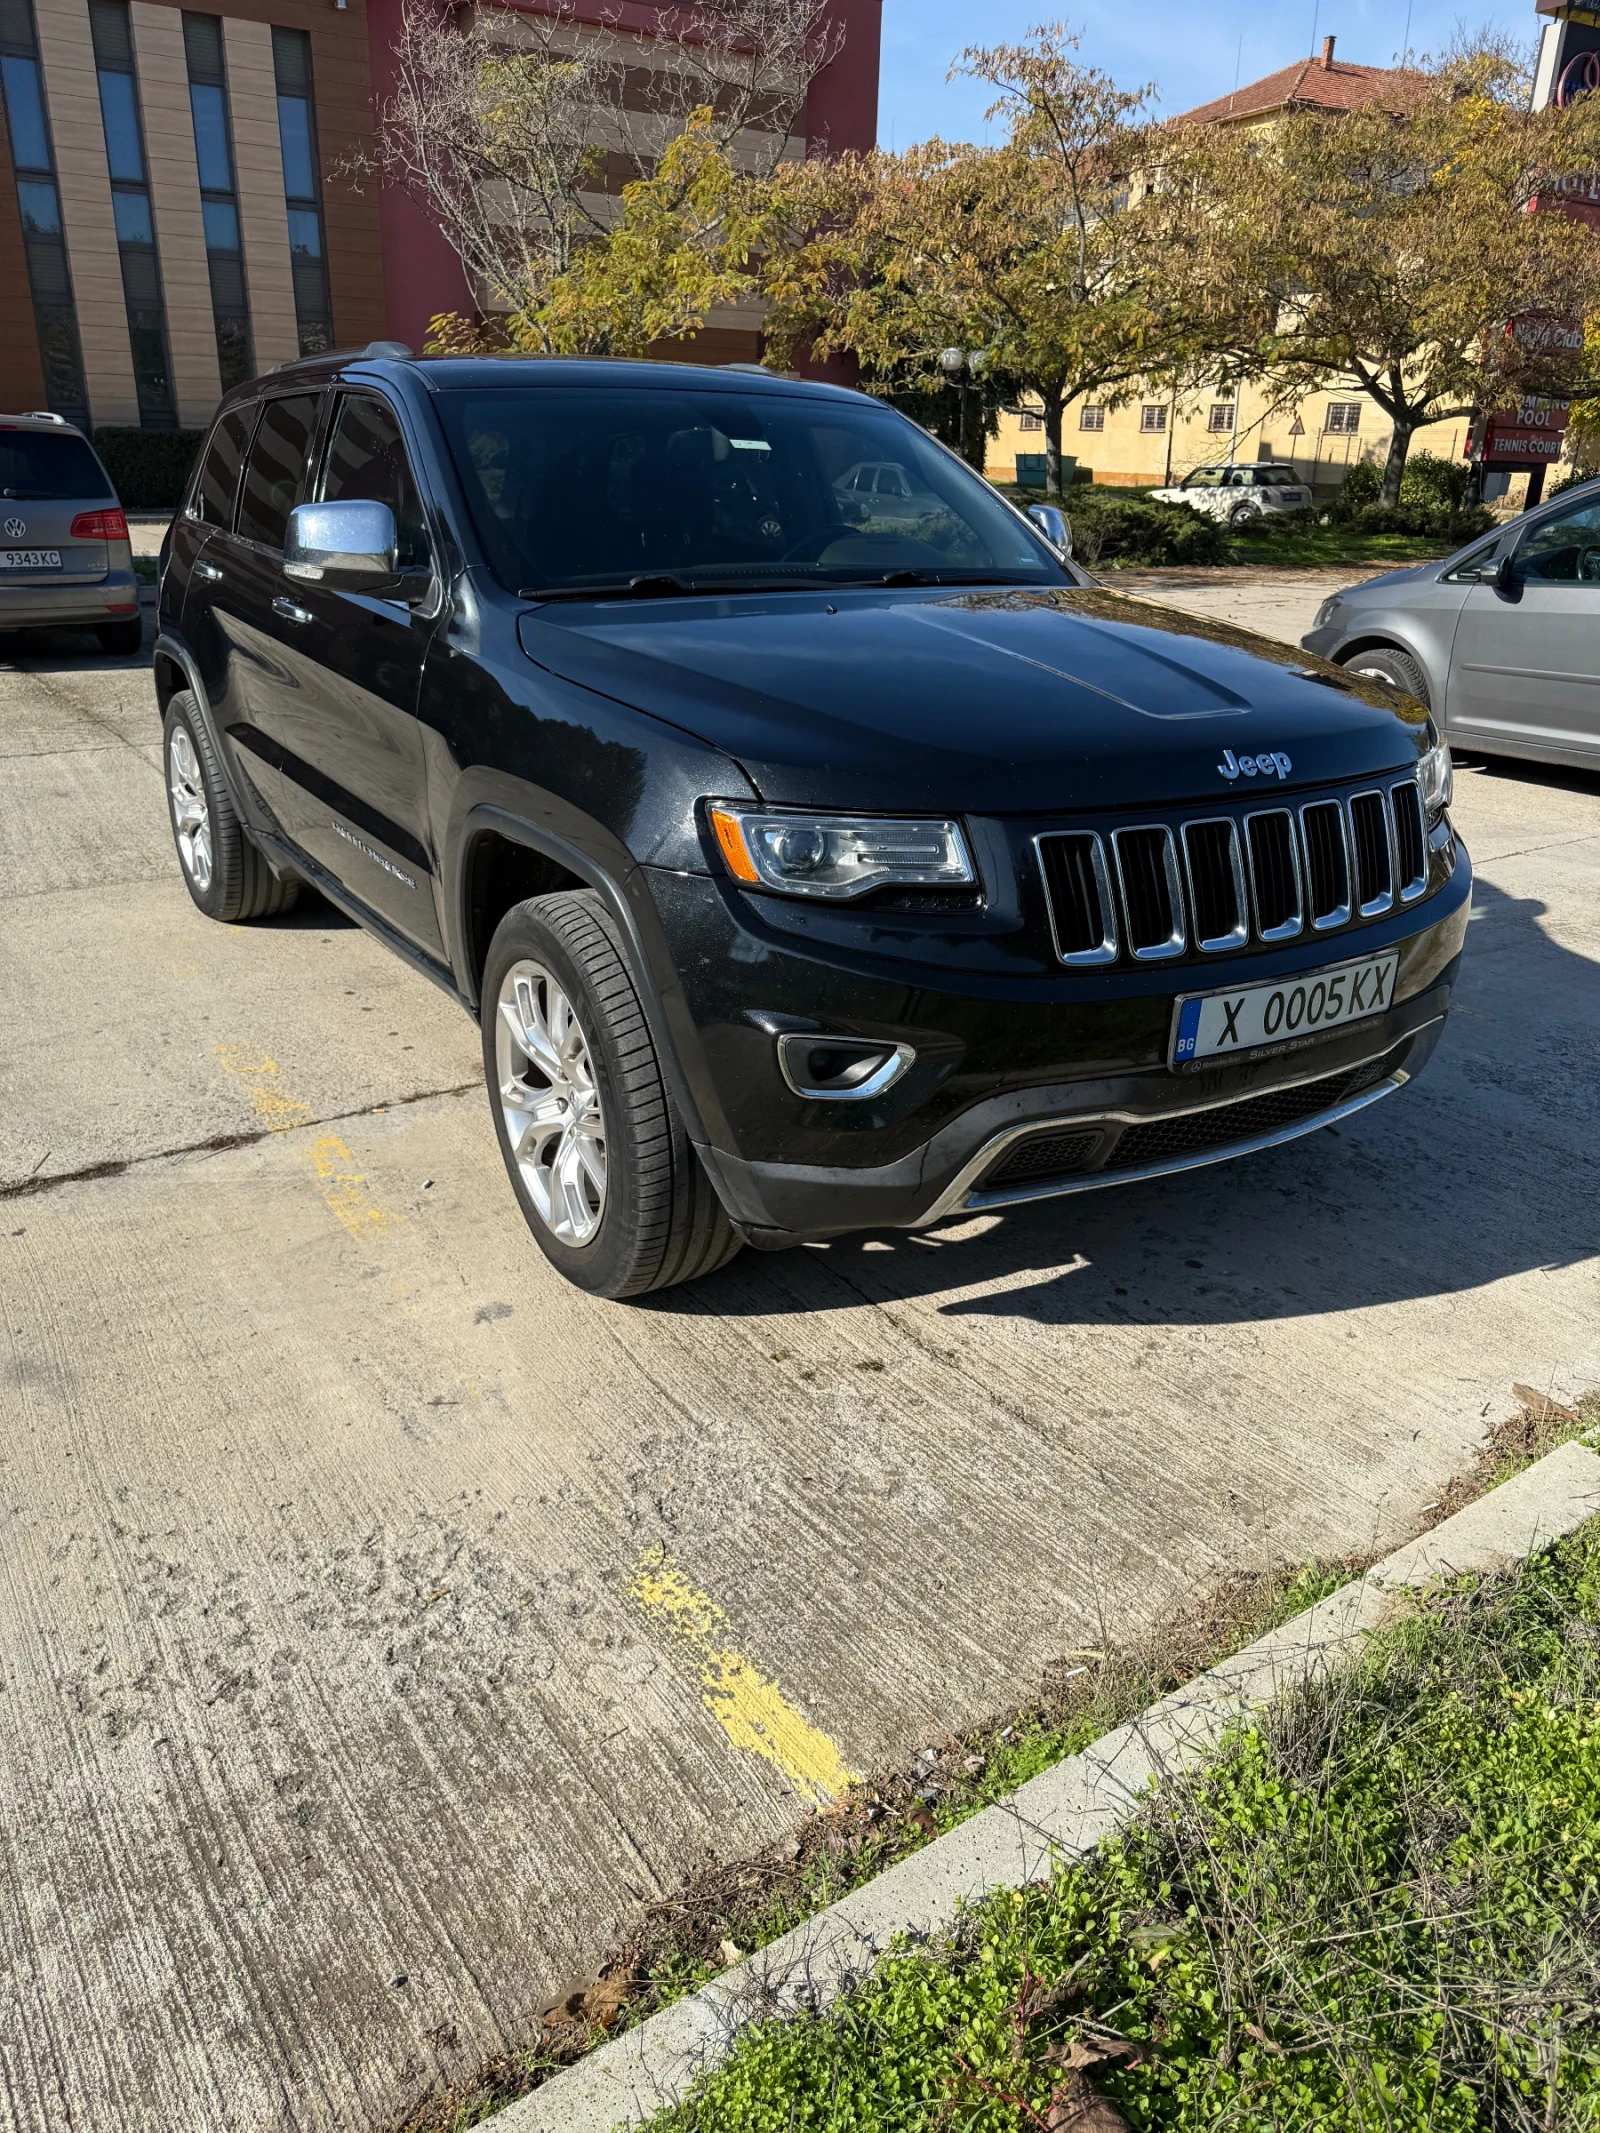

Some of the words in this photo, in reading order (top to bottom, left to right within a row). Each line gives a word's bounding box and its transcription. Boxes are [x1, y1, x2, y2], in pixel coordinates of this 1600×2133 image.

[1553, 326, 1583, 349] Club
[1516, 409, 1550, 426] POOL
[1493, 438, 1528, 453] TENNIS
[1529, 440, 1561, 455] COURT
[1217, 749, 1292, 780] Jeep
[1216, 997, 1246, 1047] X
[1177, 1037, 1195, 1053] BG
[1249, 1045, 1286, 1060] SILVER
[1289, 1037, 1315, 1050] STAR
